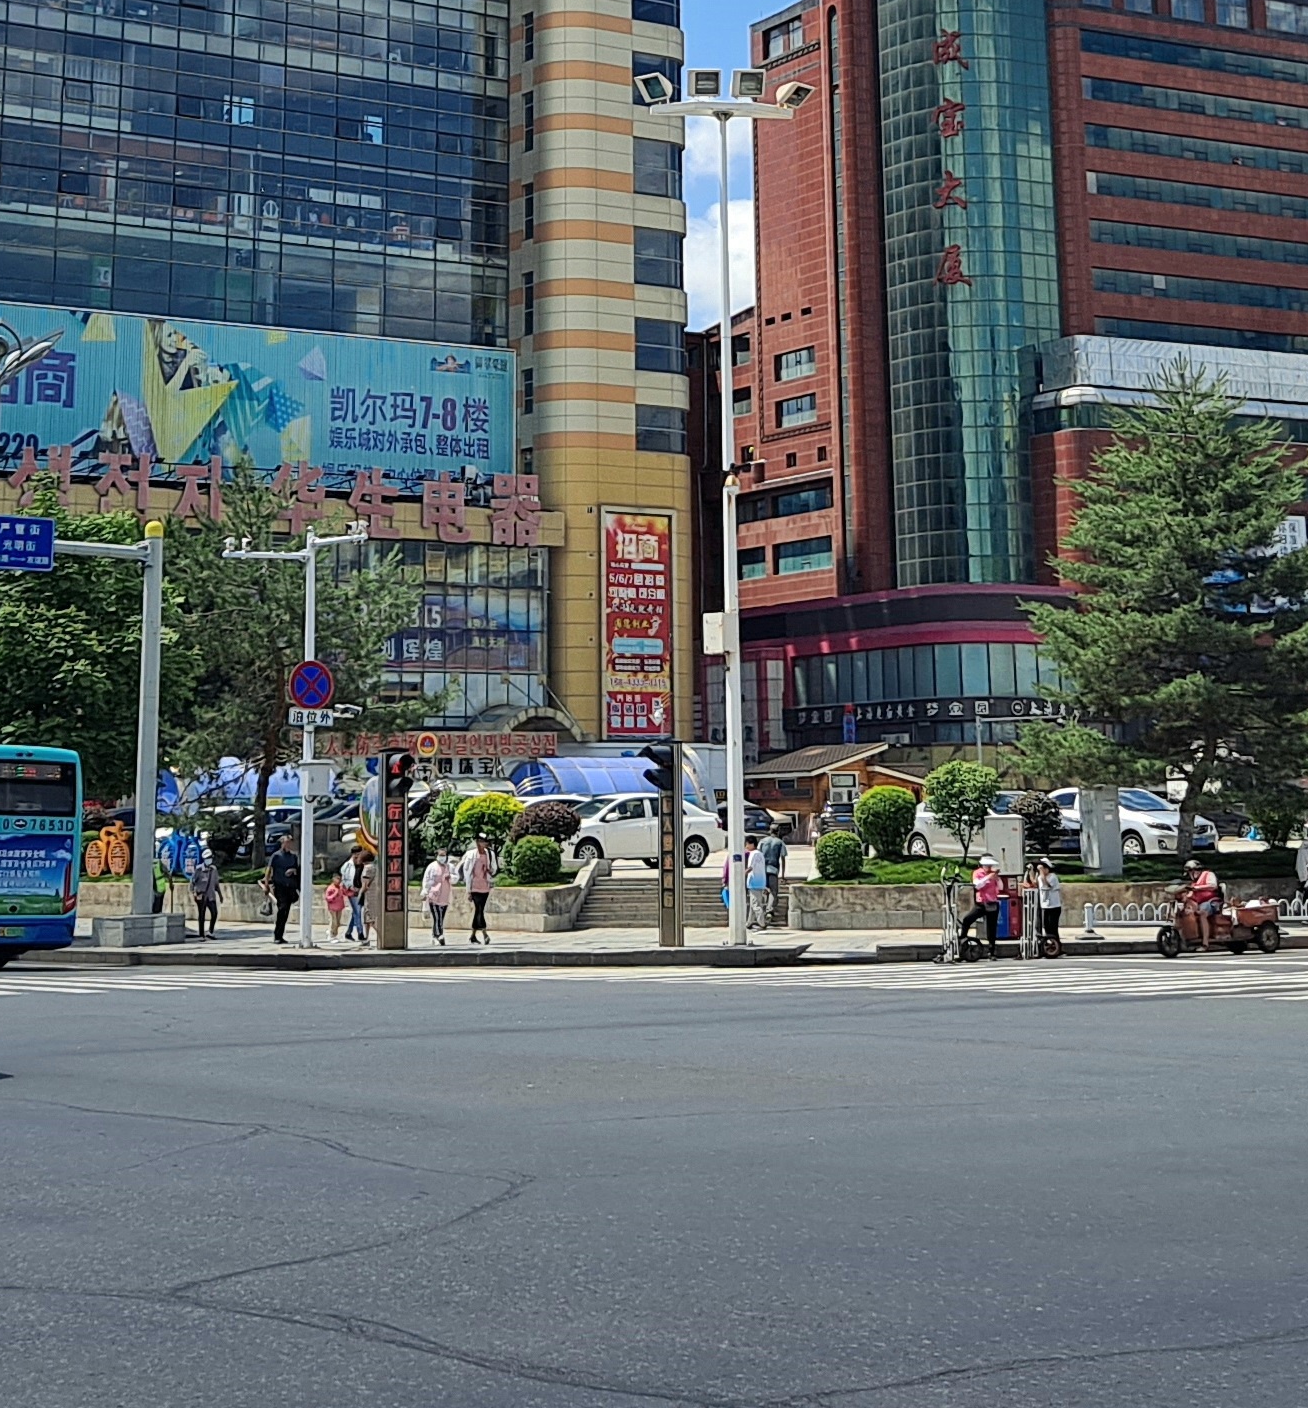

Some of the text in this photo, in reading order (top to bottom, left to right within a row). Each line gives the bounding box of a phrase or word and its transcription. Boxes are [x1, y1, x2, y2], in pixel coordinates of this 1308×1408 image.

[330, 385, 490, 434] 凯尔玛7-8楼
[616, 533, 659, 561] 招商
[292, 710, 331, 724] 泊位外
